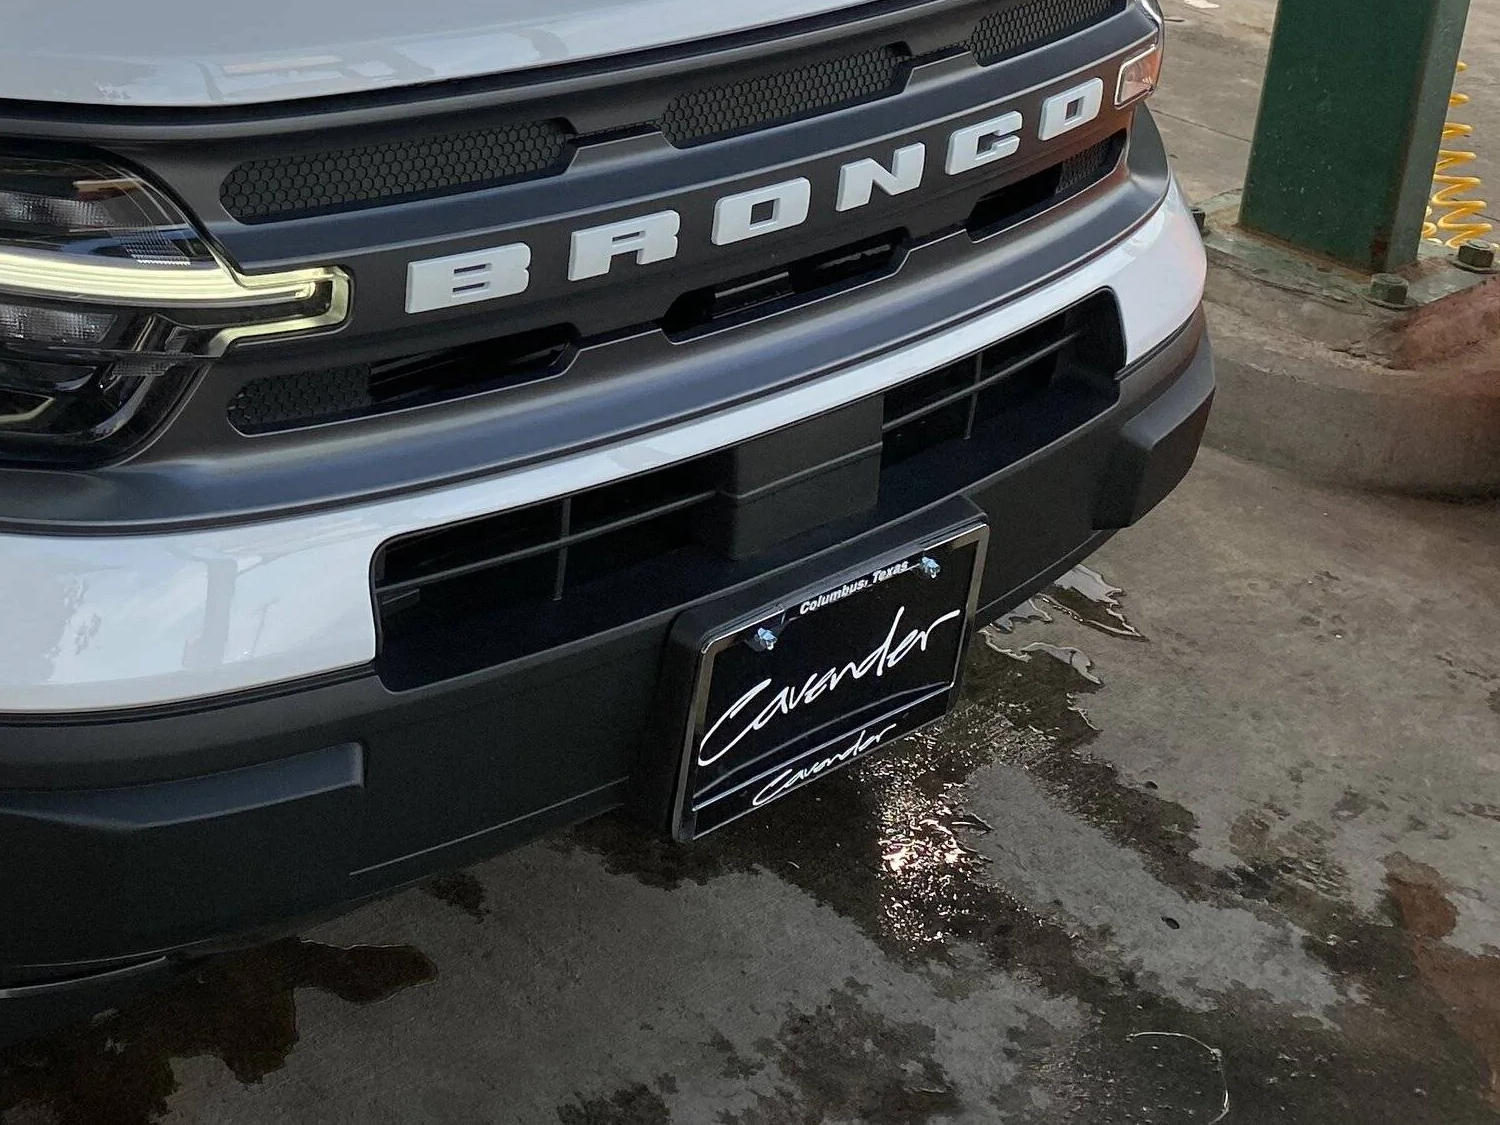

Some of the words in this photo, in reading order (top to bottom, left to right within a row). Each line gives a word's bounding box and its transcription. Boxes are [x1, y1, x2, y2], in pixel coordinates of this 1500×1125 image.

[404, 78, 1104, 315] BRONCO
[871, 559, 910, 587] Texas
[698, 606, 960, 767] Cavender
[752, 724, 897, 807] Cavender
